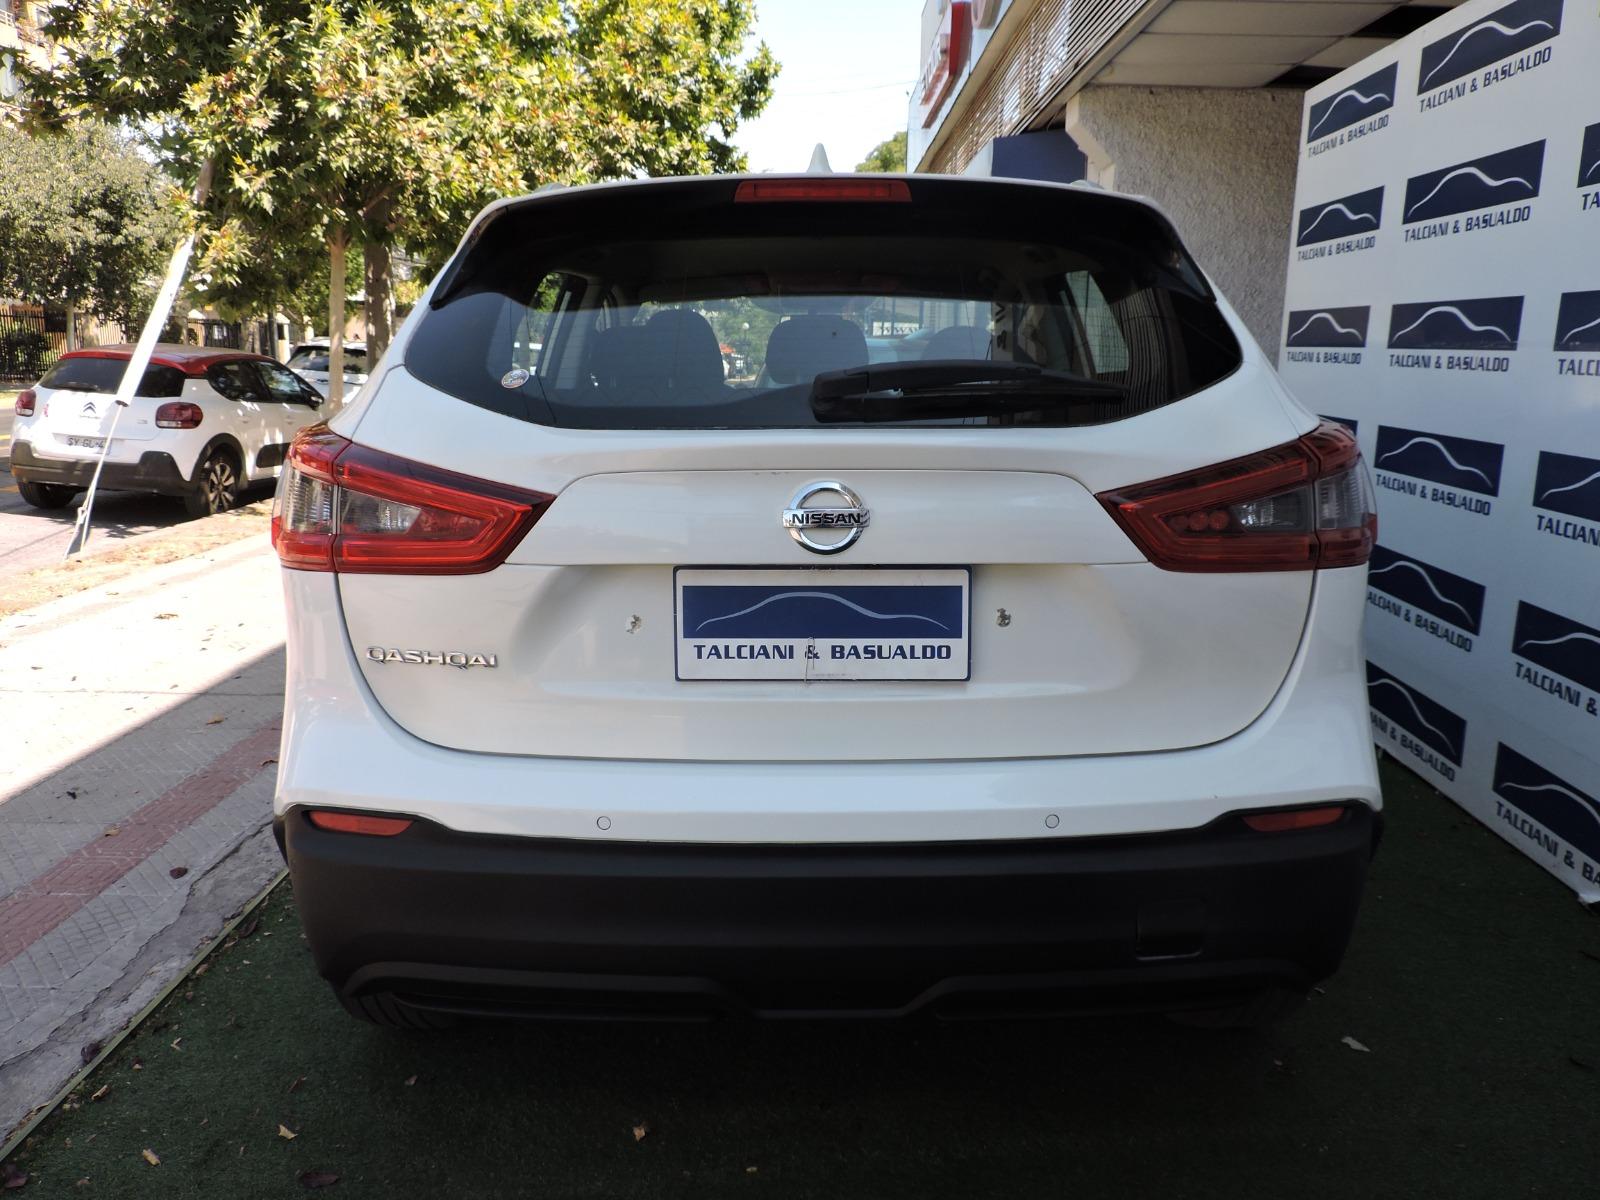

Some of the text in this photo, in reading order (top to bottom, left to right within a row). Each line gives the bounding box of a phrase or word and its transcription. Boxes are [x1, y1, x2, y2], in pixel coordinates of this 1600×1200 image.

[1420, 46, 1552, 112] TALCIANI & BASUALDO
[1339, 133, 1345, 146] &
[1405, 205, 1531, 242] TALCIANI & BASUALDO
[1328, 244, 1333, 256] &
[1390, 354, 1510, 373] TALCIANI & BASUALDO
[1376, 474, 1492, 516] TALCIANI & BASUALDO
[792, 513, 861, 524] NISSAN
[1404, 609, 1412, 623] &
[1415, 614, 1473, 653] BASUALDO
[366, 645, 499, 670] QASHQAI
[693, 644, 952, 661] TALCIANI & BASUALDO
[1516, 661, 1598, 717] TALCIANI &
[1390, 726, 1397, 741] &
[1496, 800, 1559, 857] TALCIANI
[1563, 849, 1575, 869] &
